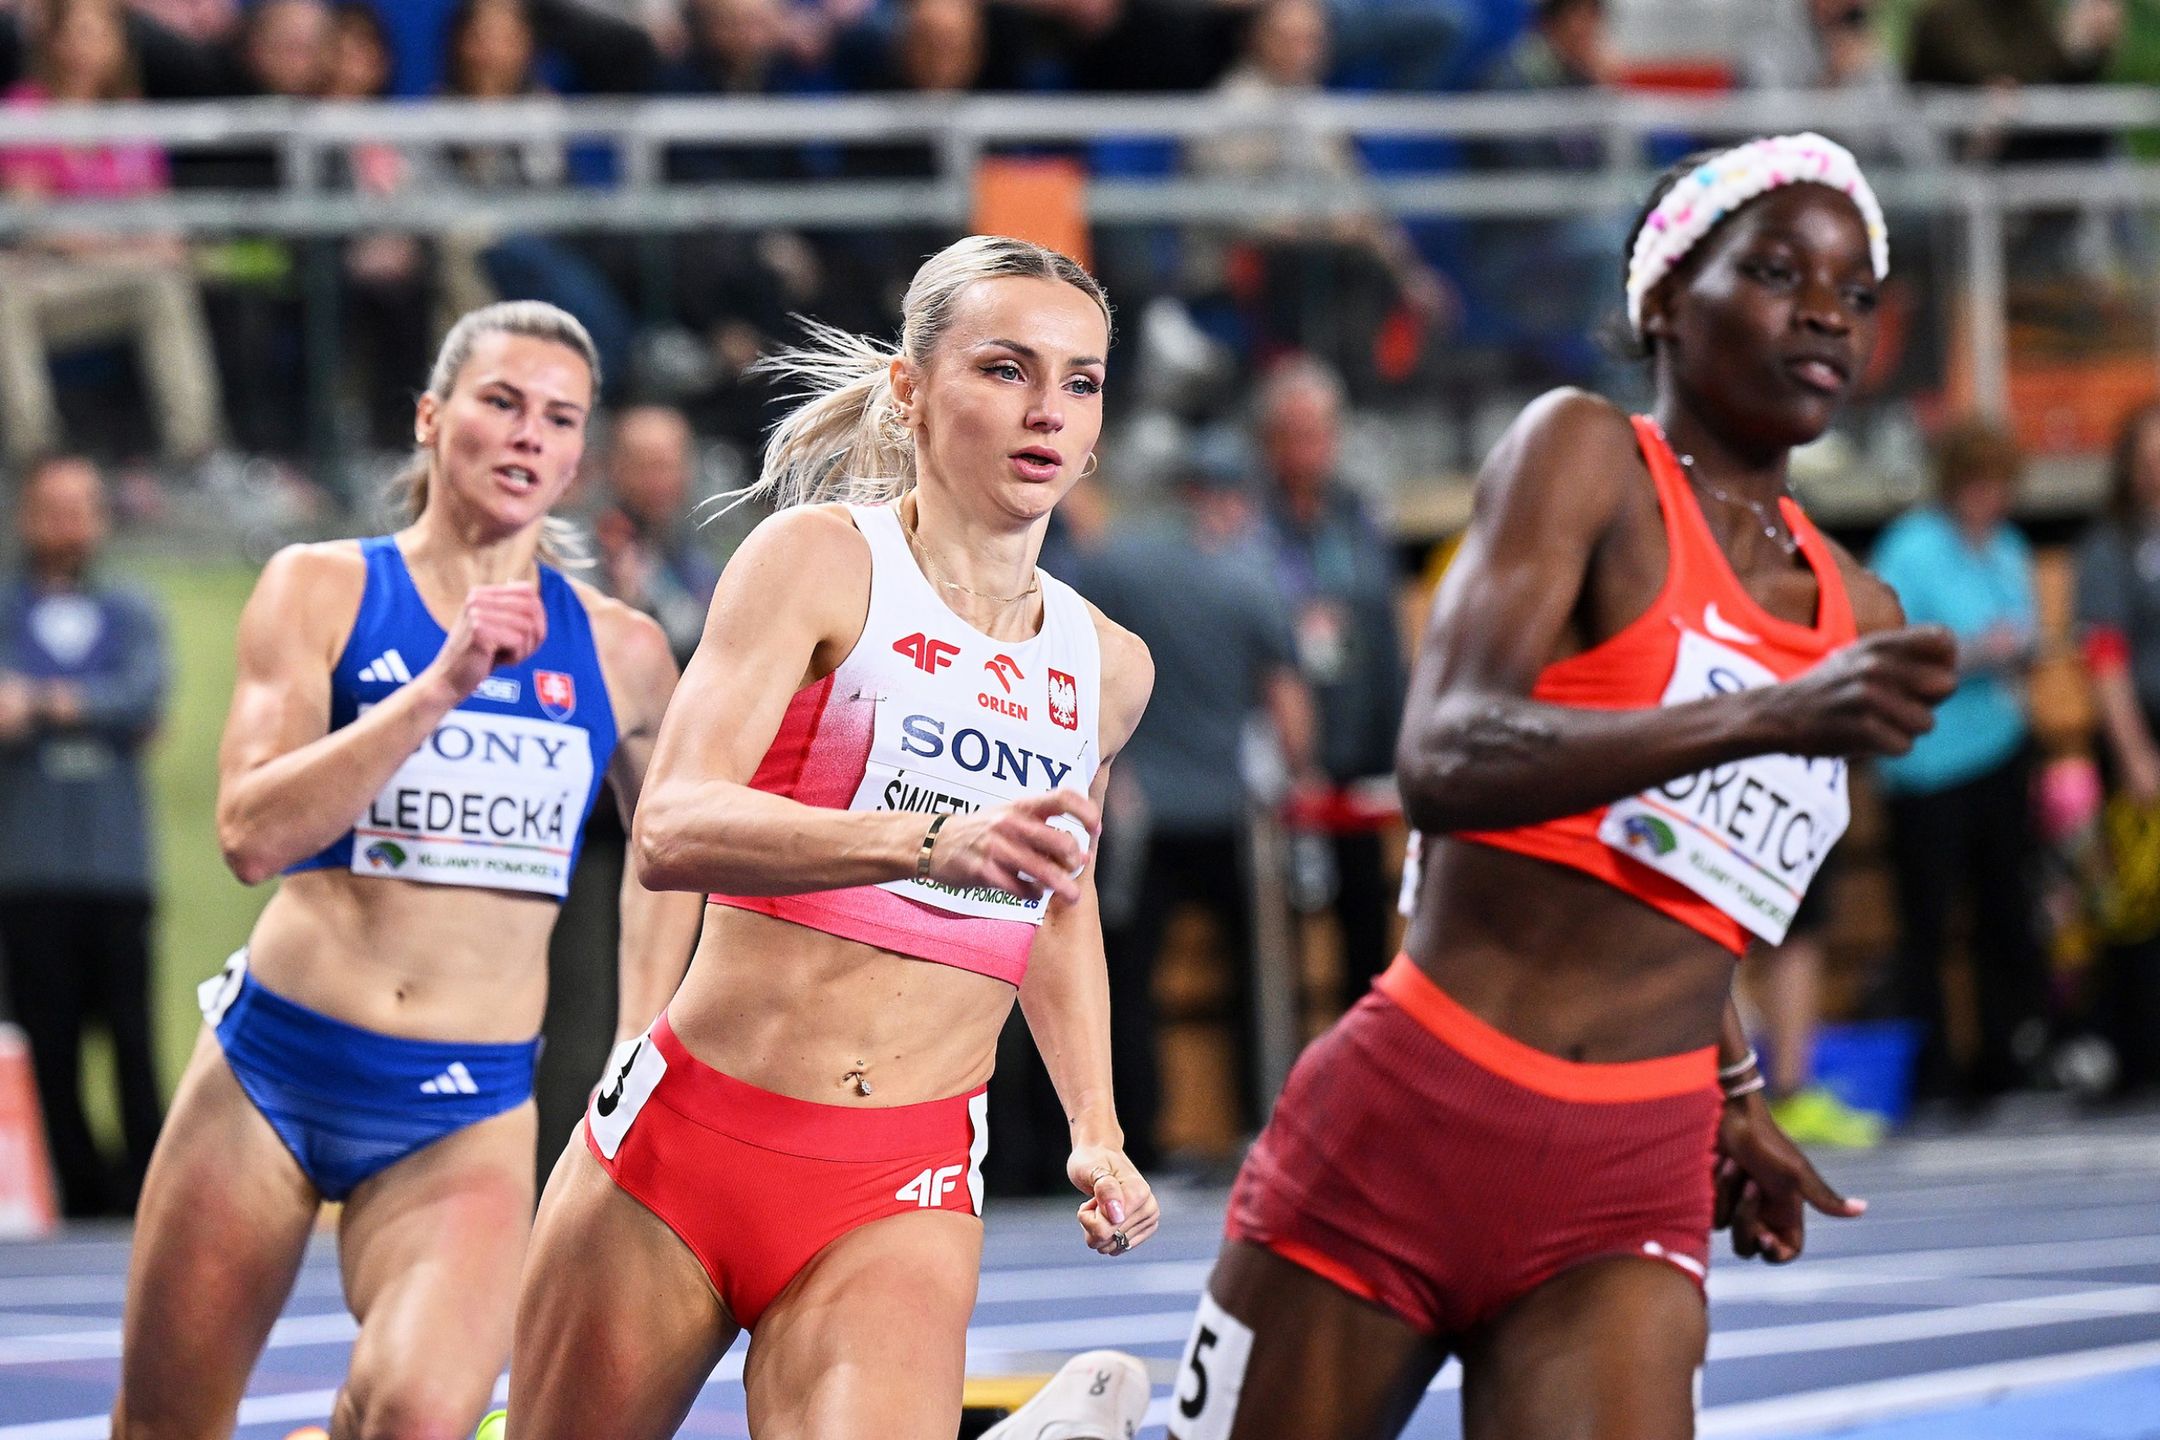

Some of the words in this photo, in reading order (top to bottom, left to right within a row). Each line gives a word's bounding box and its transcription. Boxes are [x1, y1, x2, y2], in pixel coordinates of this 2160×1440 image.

[892, 632, 961, 675] 4F
[977, 692, 1028, 721] ORLEN
[418, 725, 567, 768] ONY
[901, 714, 1072, 792] SONY
[370, 788, 570, 842] LEDECKÁ
[906, 877, 973, 899] UJAWY
[895, 1164, 963, 1207] 4F
[1179, 1324, 1218, 1420] 5
